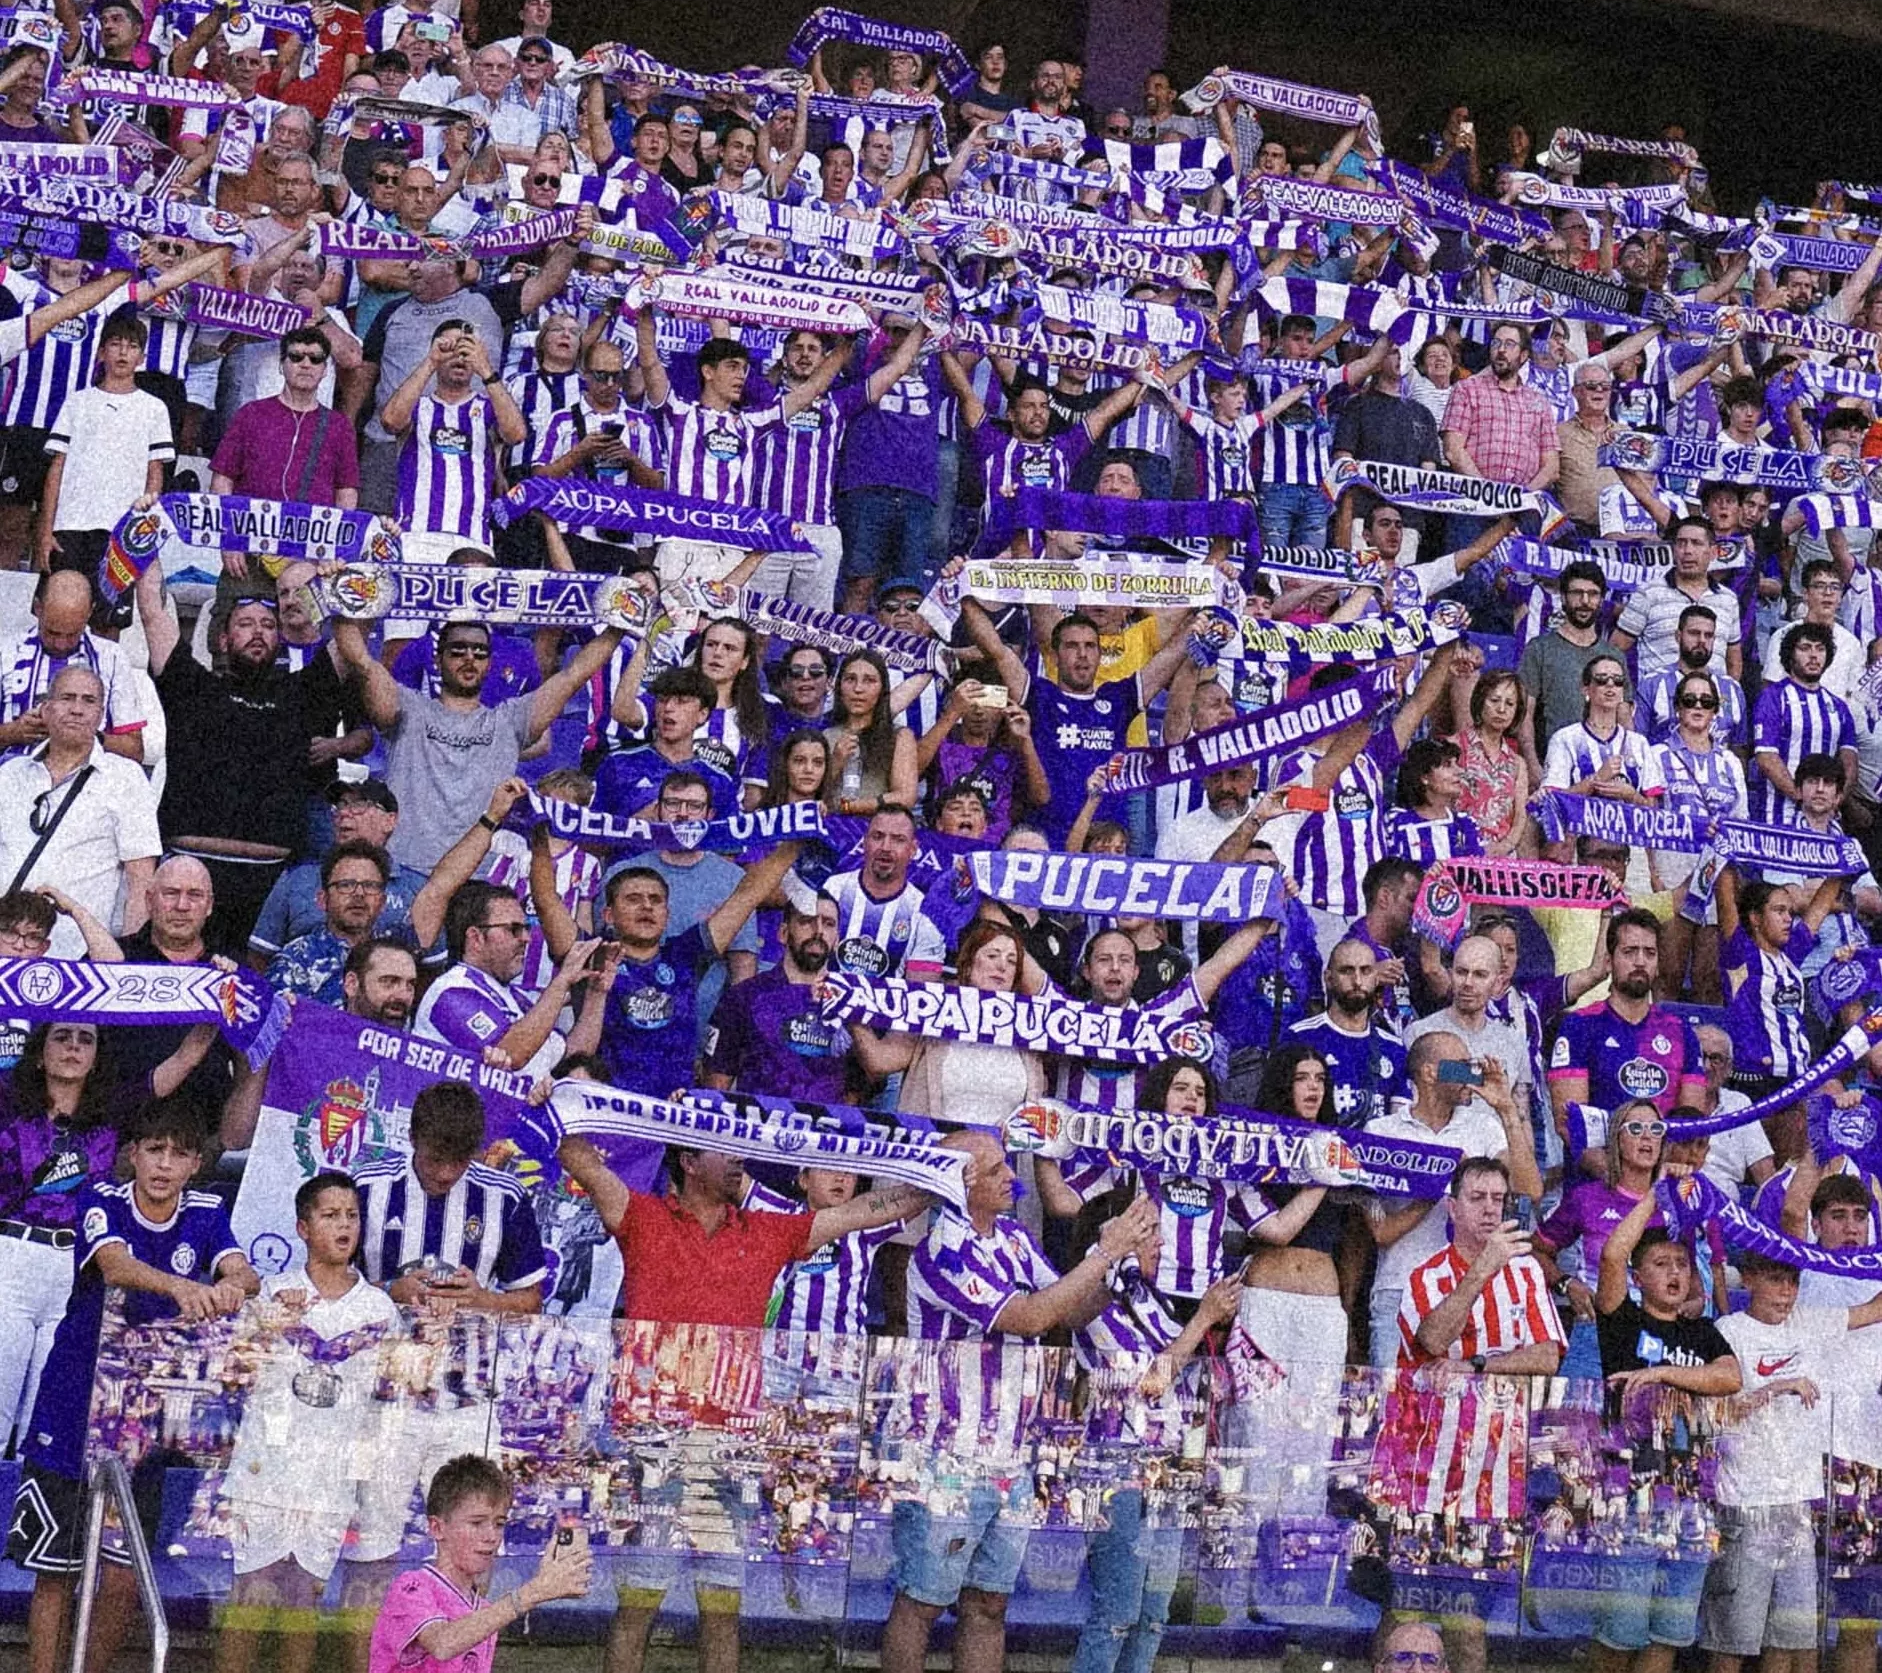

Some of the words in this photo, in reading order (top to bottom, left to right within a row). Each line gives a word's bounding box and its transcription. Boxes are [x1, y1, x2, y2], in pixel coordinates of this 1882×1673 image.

[1232, 78, 1268, 99] REAL
[1271, 87, 1360, 120] VALLADOLID
[1261, 181, 1303, 207] REAL
[1560, 187, 1598, 201] REAL
[1017, 230, 1189, 277] VALLADOLID
[683, 280, 721, 300] REAL
[730, 289, 820, 314] VALLADOLID
[791, 279, 824, 295] de
[207, 288, 303, 337] VALLADOLID
[950, 320, 1146, 370] VALLADOLID
[1671, 440, 1808, 481] PUCELA
[1367, 464, 1411, 496] REAL
[1417, 470, 1523, 510] VALLADOLID
[174, 502, 225, 533] REAL
[229, 507, 358, 548] VALLADOLID
[642, 501, 771, 535] PUCELA
[1524, 540, 1545, 567] R.
[401, 574, 594, 615] PUCELA
[969, 569, 994, 589] EL
[996, 570, 1087, 593] INFIERNO
[1091, 575, 1116, 594] DE
[1119, 576, 1215, 598] ZORRILLA
[1167, 744, 1196, 775] R.
[1198, 686, 1365, 767] VALLADOLID
[1583, 797, 1628, 836] AUPA
[1632, 807, 1695, 842] PUCELA
[1725, 827, 1761, 856] REAL
[1760, 833, 1840, 867] VALLADOLID
[996, 853, 1244, 920] PUCELA
[844, 949, 878, 972] Galicia
[846, 938, 883, 961] Estrella
[116, 974, 183, 1005] 28
[850, 985, 969, 1035] AUPA
[981, 995, 1166, 1053] PUCELA
[358, 1028, 402, 1061] POR
[404, 1041, 448, 1075] SER
[445, 1053, 476, 1084] DE
[478, 1063, 530, 1101] VALL
[1625, 1068, 1662, 1082] Estrella
[1626, 1077, 1662, 1092] Galicia
[651, 1103, 763, 1141] SIEMPRE
[817, 1133, 850, 1153] MI
[1067, 1109, 1319, 1169] VALLADOLID
[1719, 1201, 1799, 1257] AUPA
